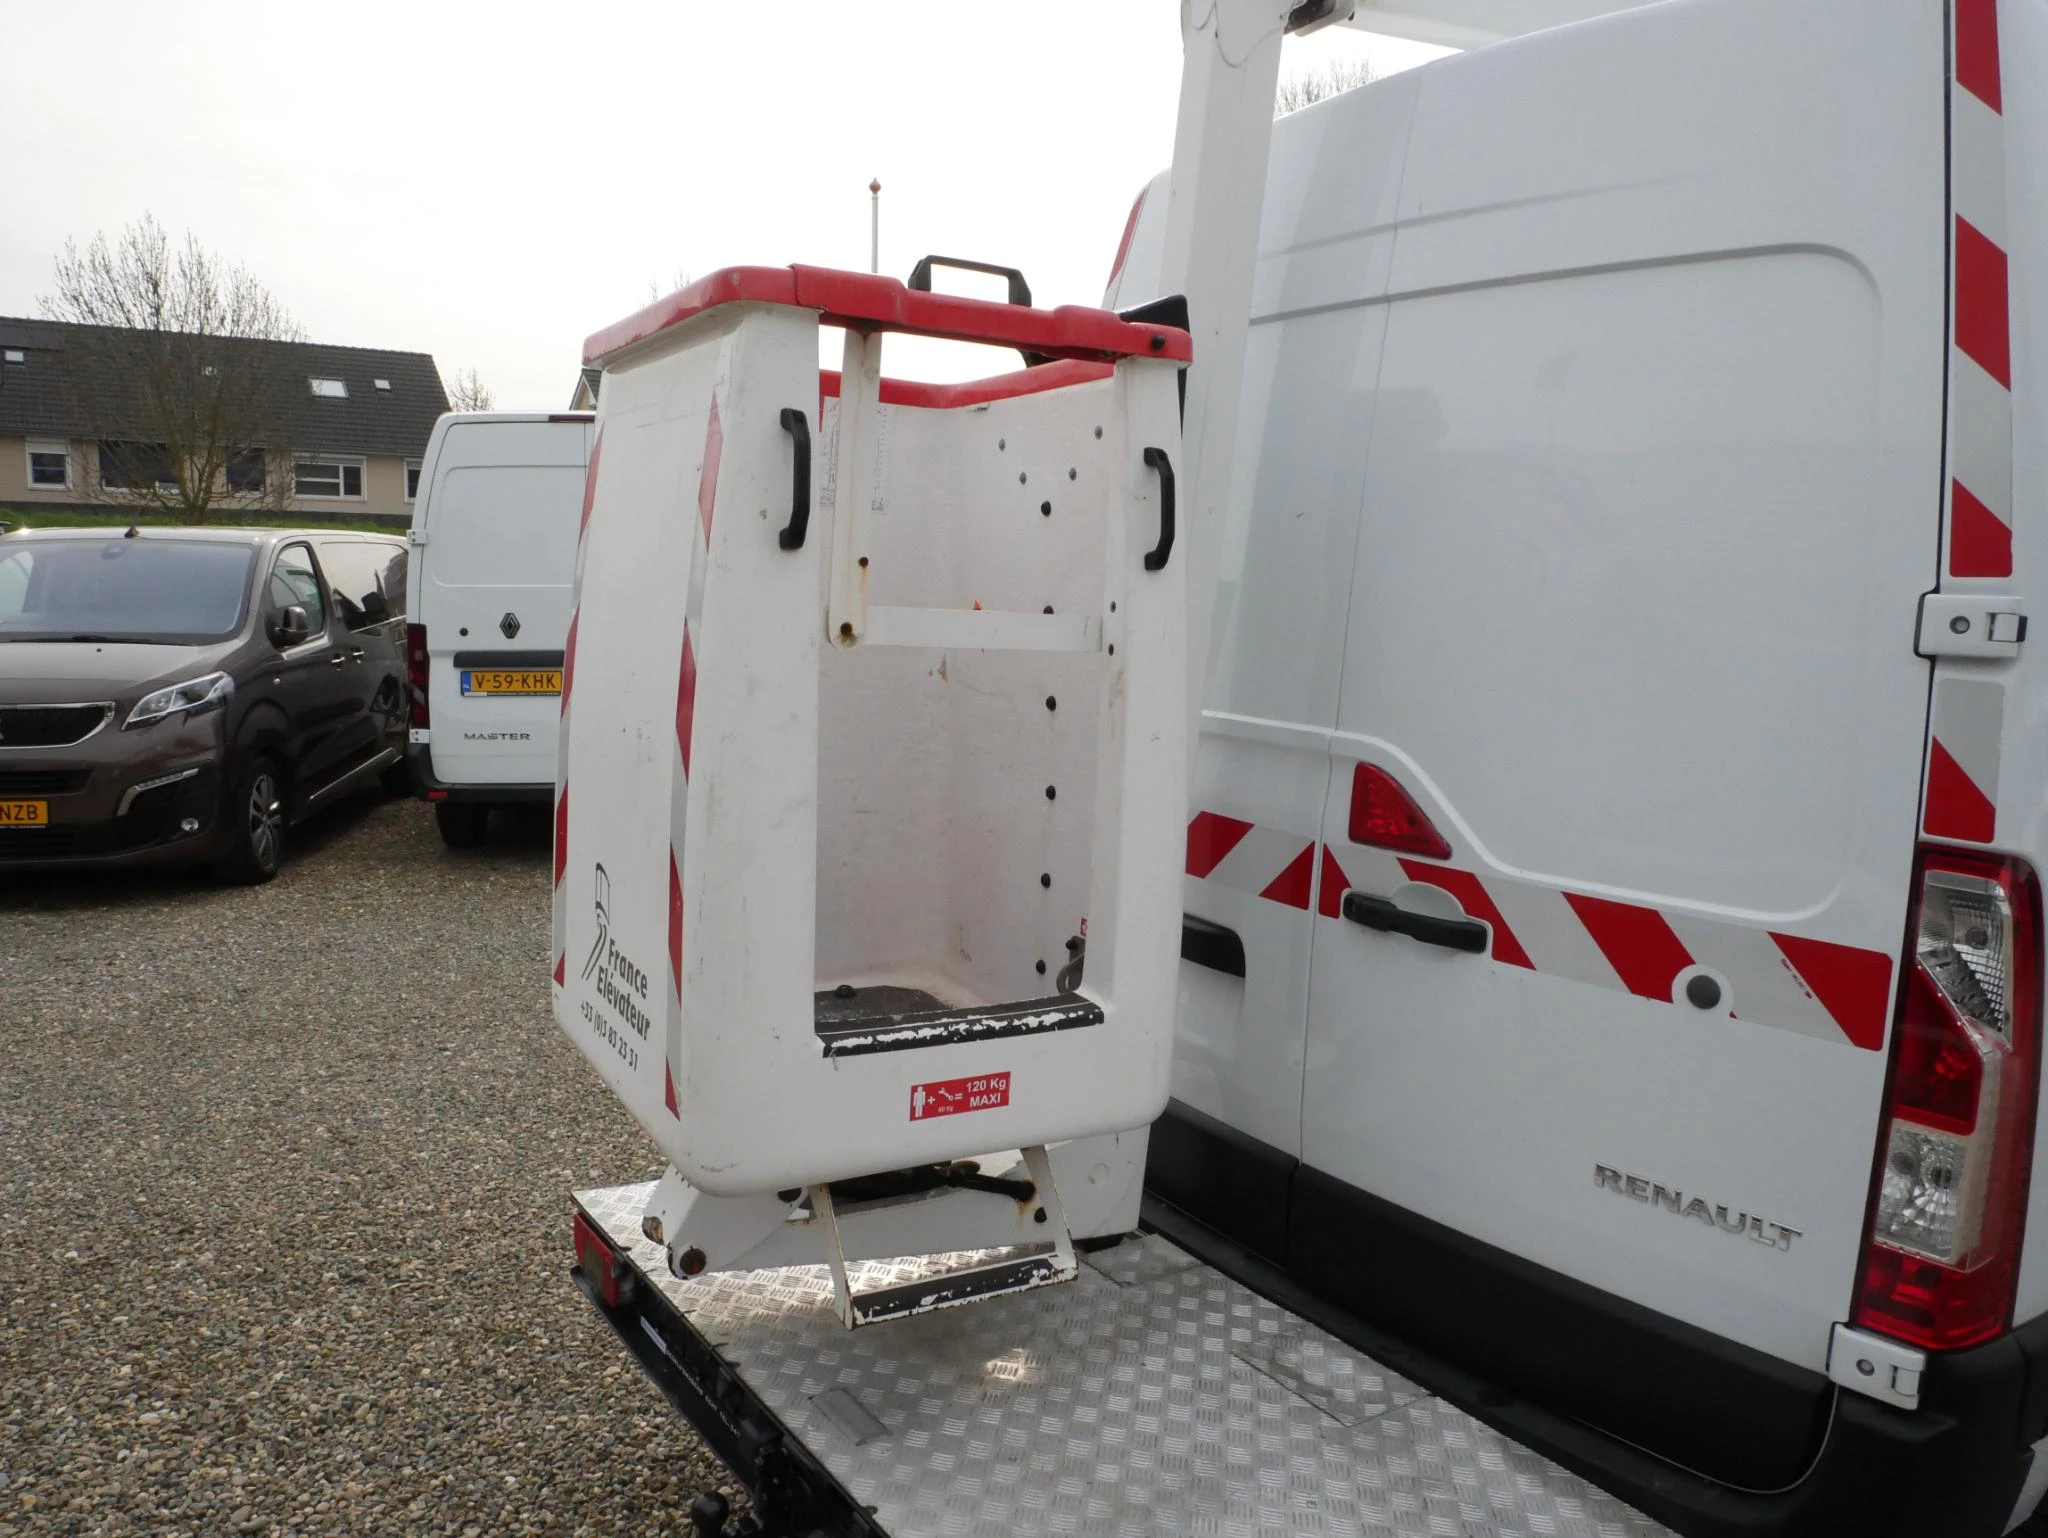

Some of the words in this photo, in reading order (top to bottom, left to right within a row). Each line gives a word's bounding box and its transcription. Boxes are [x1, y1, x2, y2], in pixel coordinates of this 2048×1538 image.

[475, 674, 556, 689] V-59-KHK
[463, 732, 530, 741] MASTER
[608, 938, 648, 1000] France
[596, 966, 651, 1041] Elévateur
[580, 1000, 593, 1023] +33
[593, 1010, 607, 1038] (0)3
[607, 1026, 617, 1048] 83
[618, 1036, 628, 1060] 23
[629, 1048, 638, 1072] 31
[966, 1079, 987, 1093] 120
[990, 1078, 1007, 1091] Kg
[969, 1092, 1001, 1108] MAXI
[1593, 1161, 1803, 1252] RENAULT
